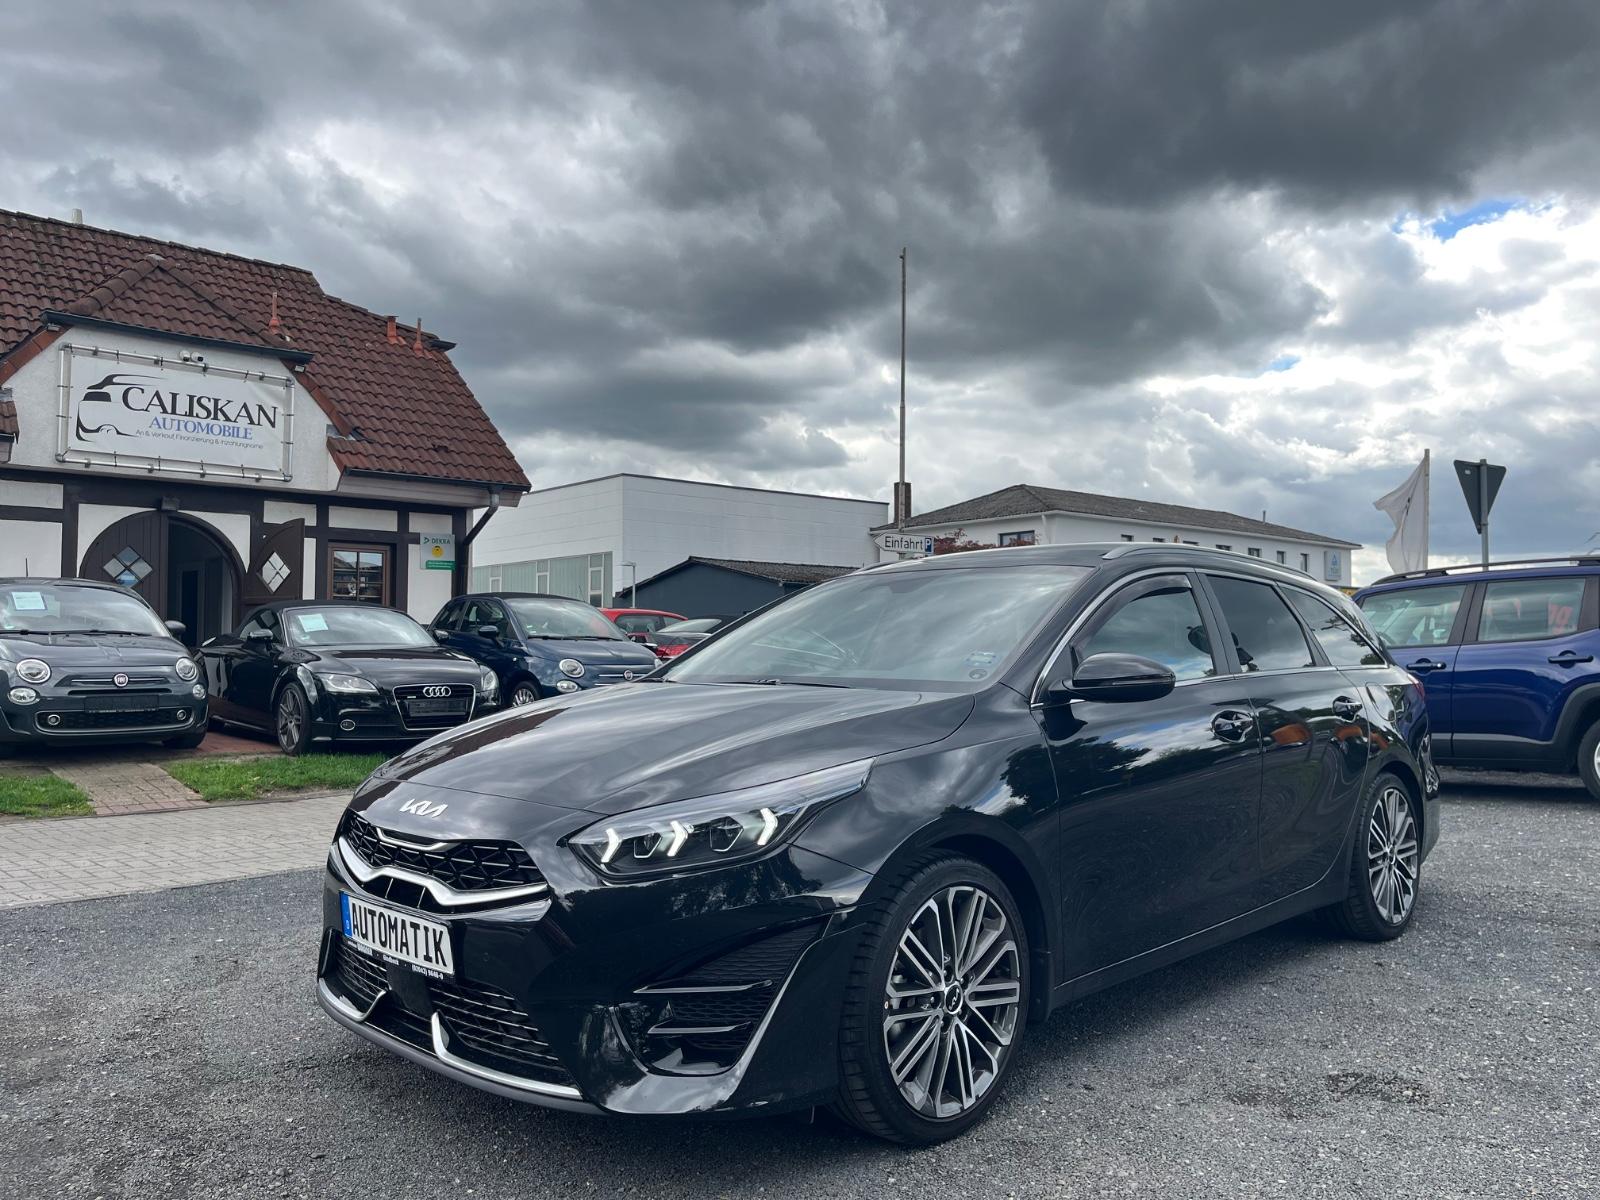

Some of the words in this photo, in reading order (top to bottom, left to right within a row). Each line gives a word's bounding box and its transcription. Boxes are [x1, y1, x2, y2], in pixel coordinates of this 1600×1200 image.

[122, 386, 278, 428] CALISKAN
[149, 416, 253, 440] AUTOMOBILE
[175, 434, 215, 445] Finanzierung
[885, 536, 923, 549] Einfahrt
[925, 539, 931, 548] P
[352, 903, 447, 967] AUTOMATIK
